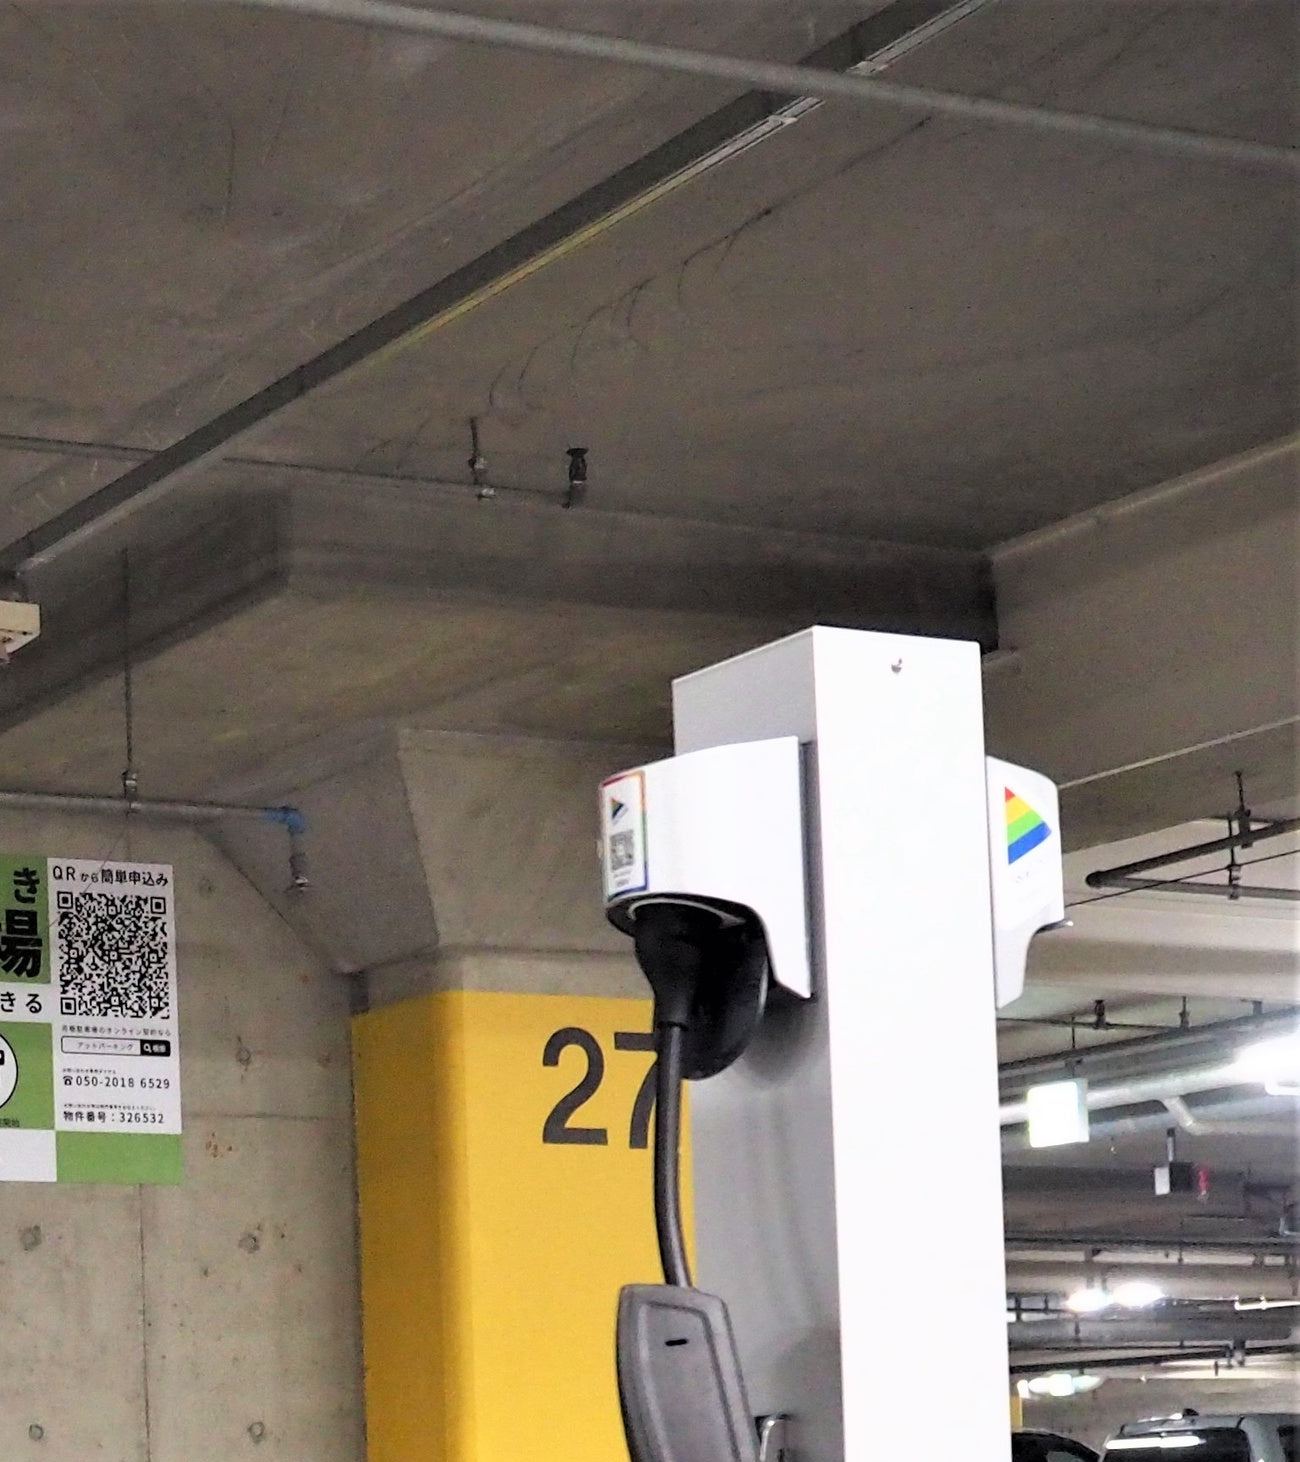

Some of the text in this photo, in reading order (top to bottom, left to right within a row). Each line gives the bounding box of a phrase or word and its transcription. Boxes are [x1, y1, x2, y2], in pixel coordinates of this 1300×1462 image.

[52, 865, 168, 887] QRから簡単申込み
[542, 1027, 658, 1149] 27
